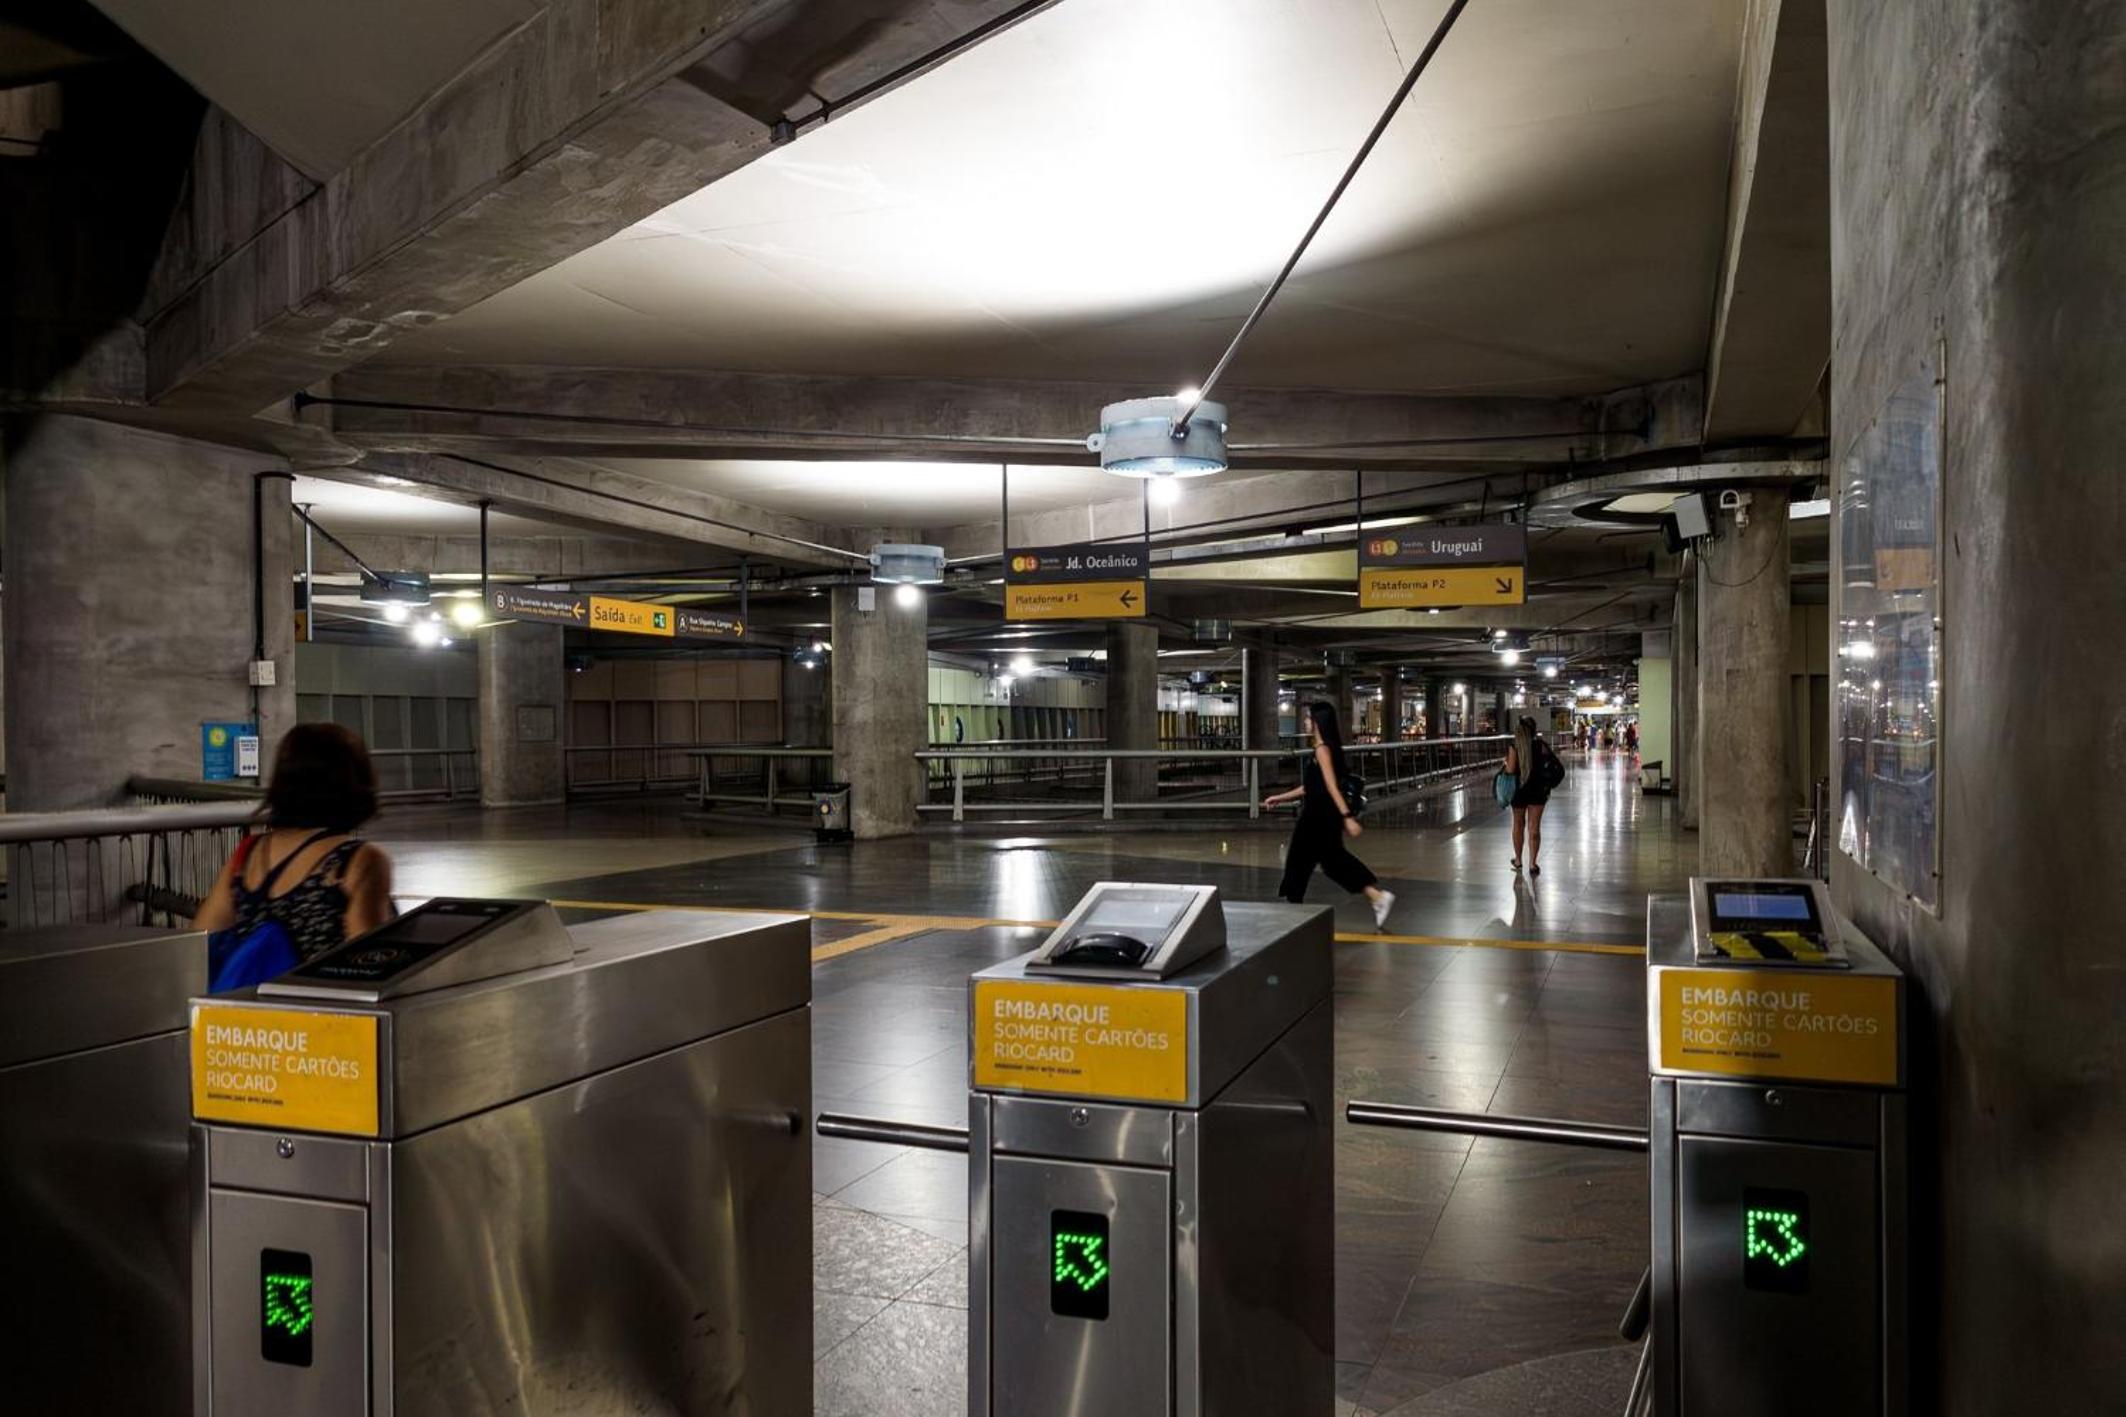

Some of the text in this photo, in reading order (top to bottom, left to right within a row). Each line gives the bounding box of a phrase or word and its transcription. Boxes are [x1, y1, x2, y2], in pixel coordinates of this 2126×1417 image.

[1432, 538, 1482, 556] Uruguai
[1066, 556, 1082, 569] Jd.
[1086, 554, 1138, 568] Oceânico
[1372, 579, 1446, 591] Plataforma P2
[497, 594, 505, 609] B
[1016, 592, 1078, 605] Plataforma P1
[594, 605, 625, 623] Saída
[1681, 986, 1810, 1011] EMBARQUE
[994, 998, 1110, 1025] EMBARQUE
[1681, 1008, 1878, 1035] SOMENTE CARTÕES
[206, 1025, 308, 1052] EMBARQUE
[994, 1022, 1169, 1050] SOMENTE CARTÕES
[1681, 1028, 1771, 1048] RIOCARD
[994, 1042, 1074, 1063] RIOCARD
[206, 1049, 360, 1080] SOMENTE CARTÕES
[206, 1070, 277, 1093] RIOCARD
